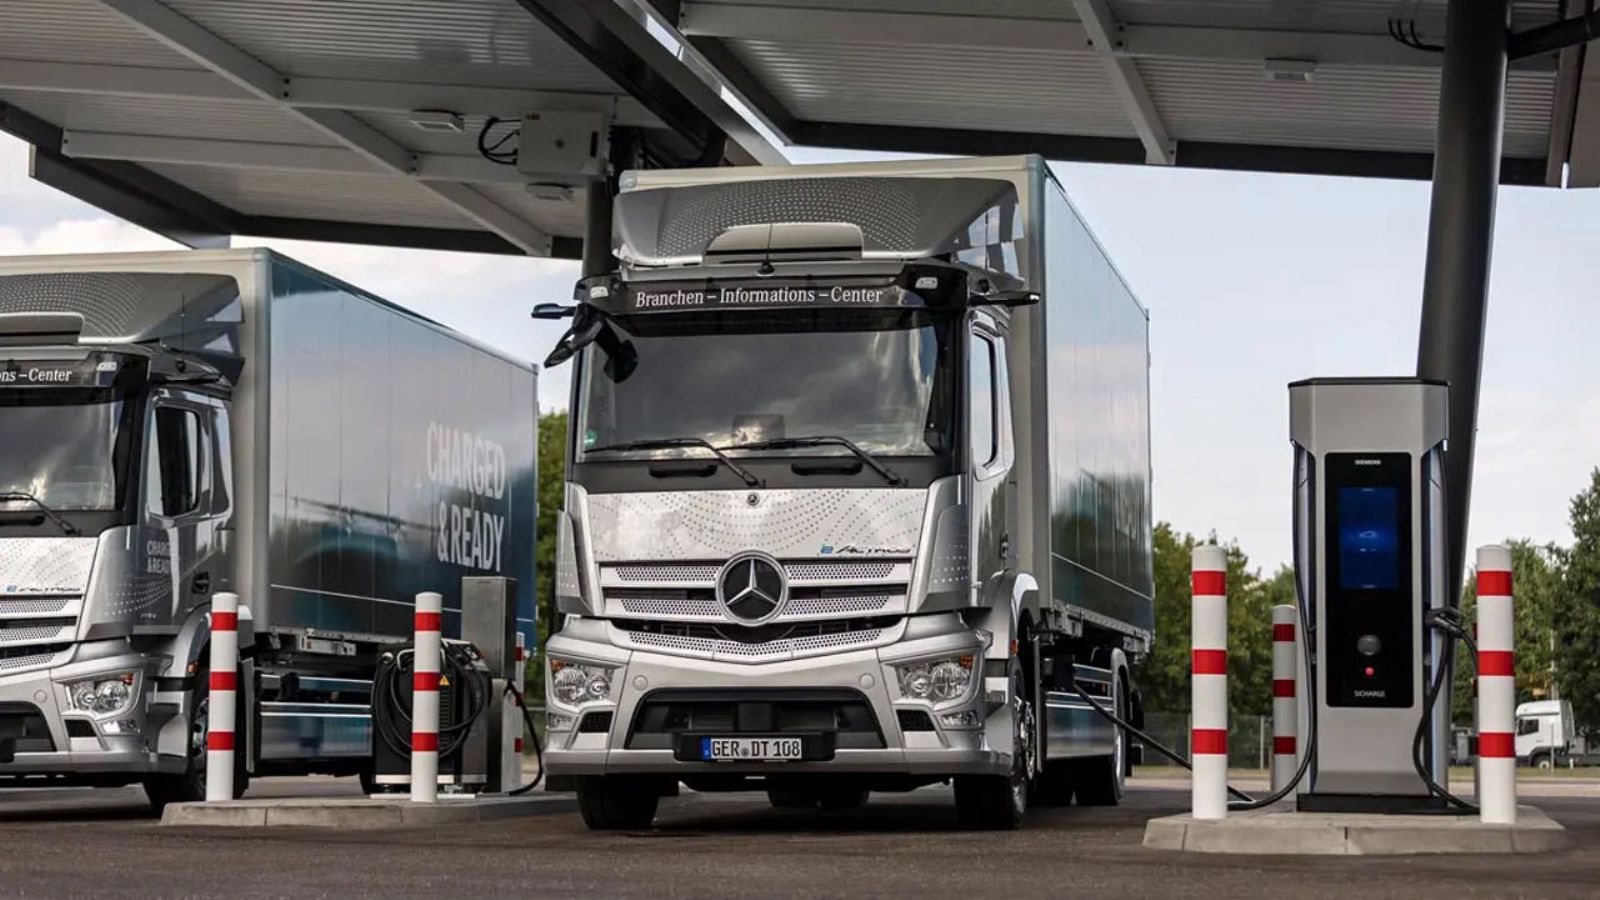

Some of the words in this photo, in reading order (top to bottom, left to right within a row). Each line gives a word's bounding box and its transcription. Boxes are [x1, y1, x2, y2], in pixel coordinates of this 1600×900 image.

[636, 291, 703, 307] Branchen
[720, 287, 815, 303] Informations
[831, 286, 883, 302] Center
[28, 368, 72, 381] Center
[427, 422, 505, 499] CHARGED
[712, 741, 740, 757] GER
[751, 741, 769, 757] DT
[773, 741, 800, 757] 108
